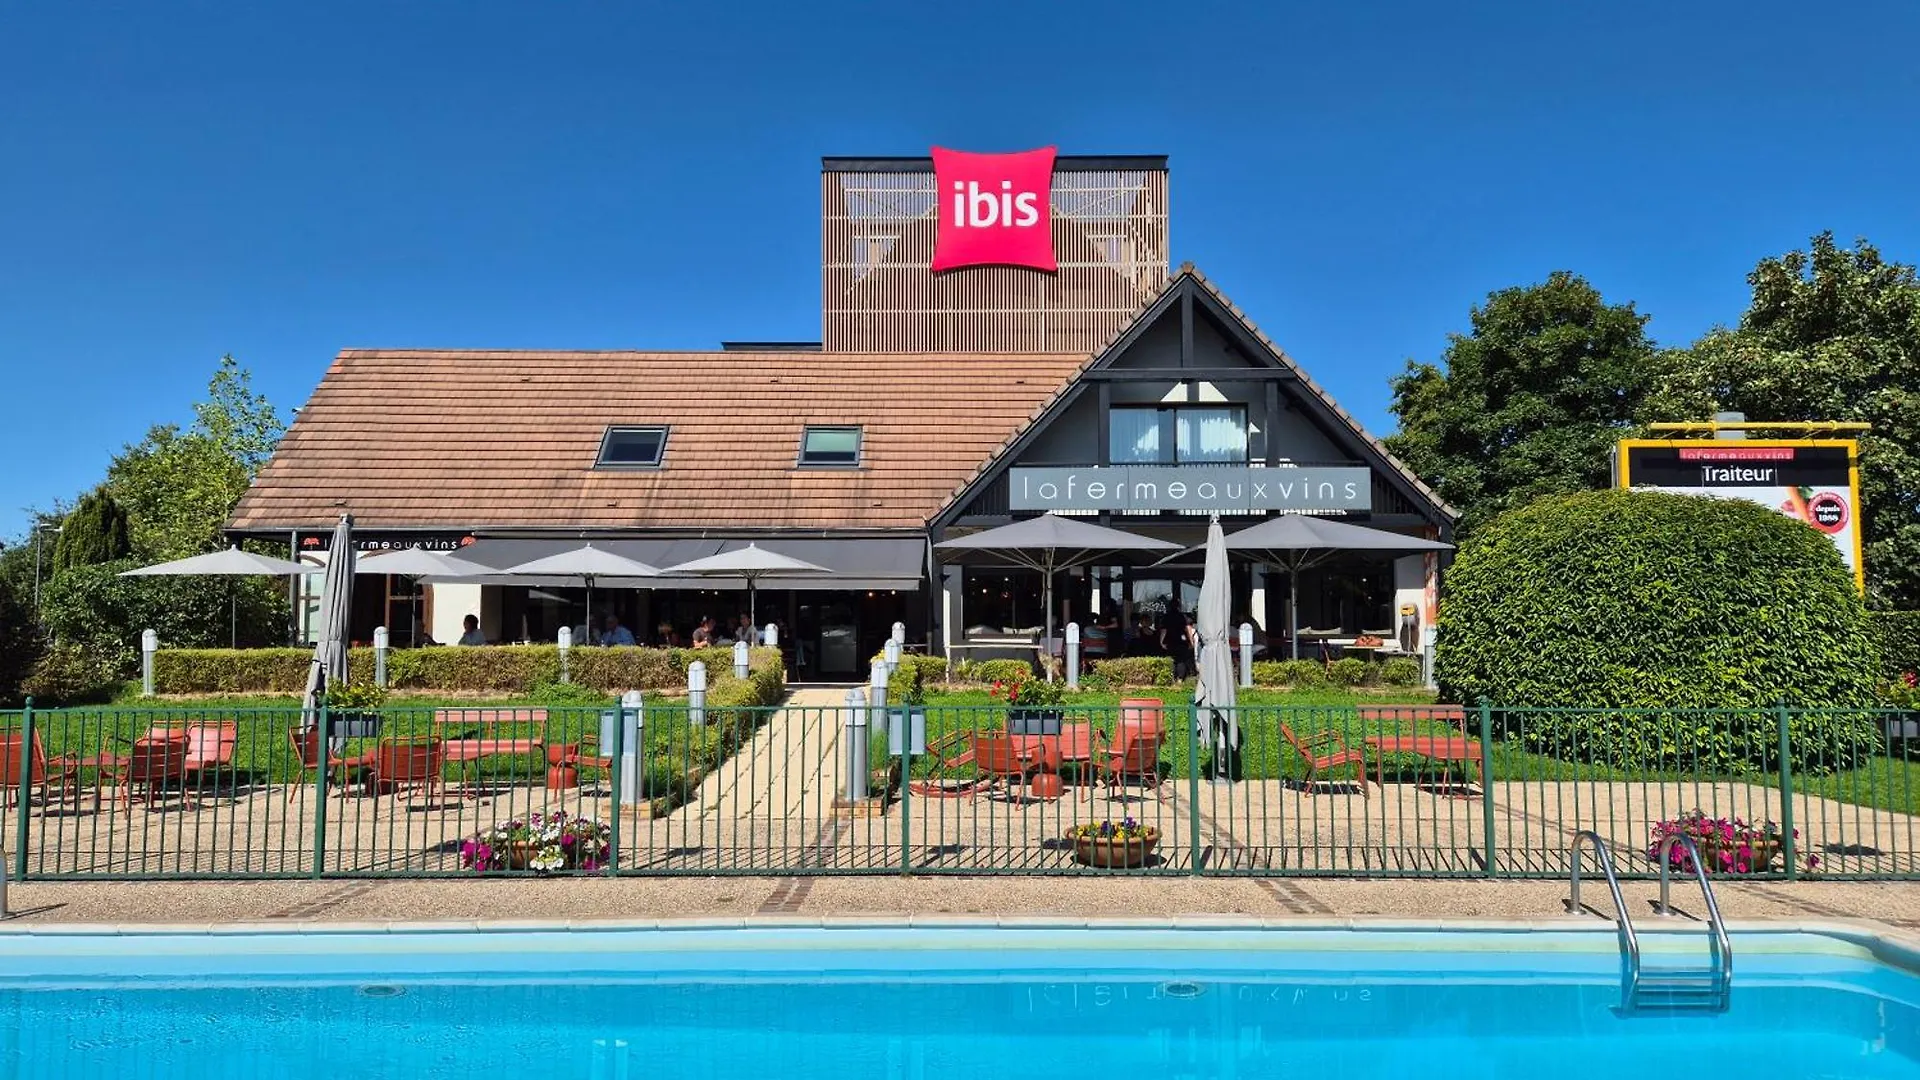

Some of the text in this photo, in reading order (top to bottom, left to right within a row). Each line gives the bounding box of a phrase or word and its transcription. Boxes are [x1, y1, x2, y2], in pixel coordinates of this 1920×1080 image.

[954, 180, 1039, 228] ibis
[1702, 465, 1773, 482] Traiteur
[1024, 475, 1357, 500] lafermeauxvins
